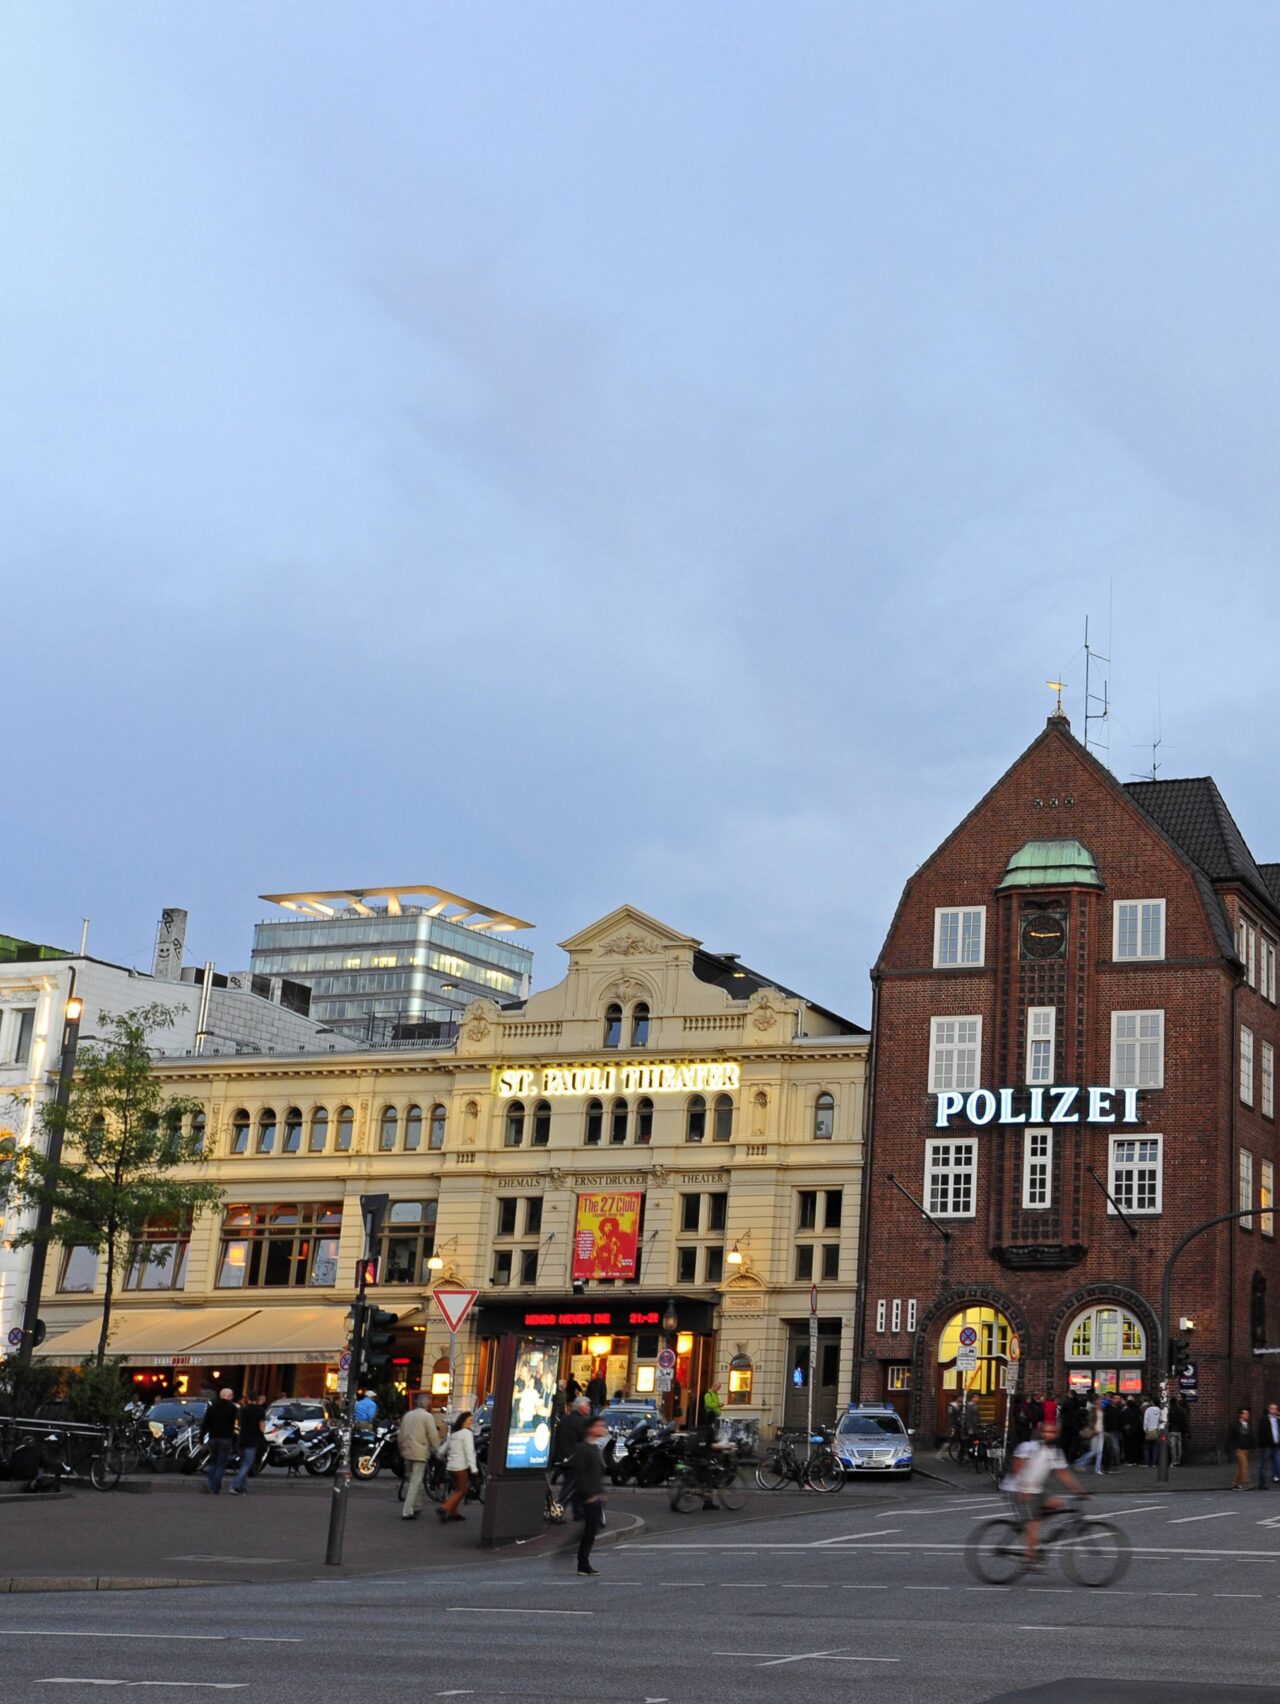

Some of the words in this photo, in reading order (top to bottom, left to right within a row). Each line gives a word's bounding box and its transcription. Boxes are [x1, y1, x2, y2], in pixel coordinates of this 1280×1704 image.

[499, 1069, 537, 1096] ST.
[541, 1067, 616, 1095] PAULI
[620, 1062, 739, 1093] THEATER
[935, 1087, 1140, 1127] POLIZEI
[498, 1176, 541, 1188] EHEMALS
[574, 1175, 604, 1186] ERNST
[605, 1174, 648, 1186] DRUCKER
[681, 1173, 724, 1184] THEATER
[584, 1198, 599, 1213] The
[600, 1196, 617, 1213] 27
[616, 1197, 636, 1213] Club
